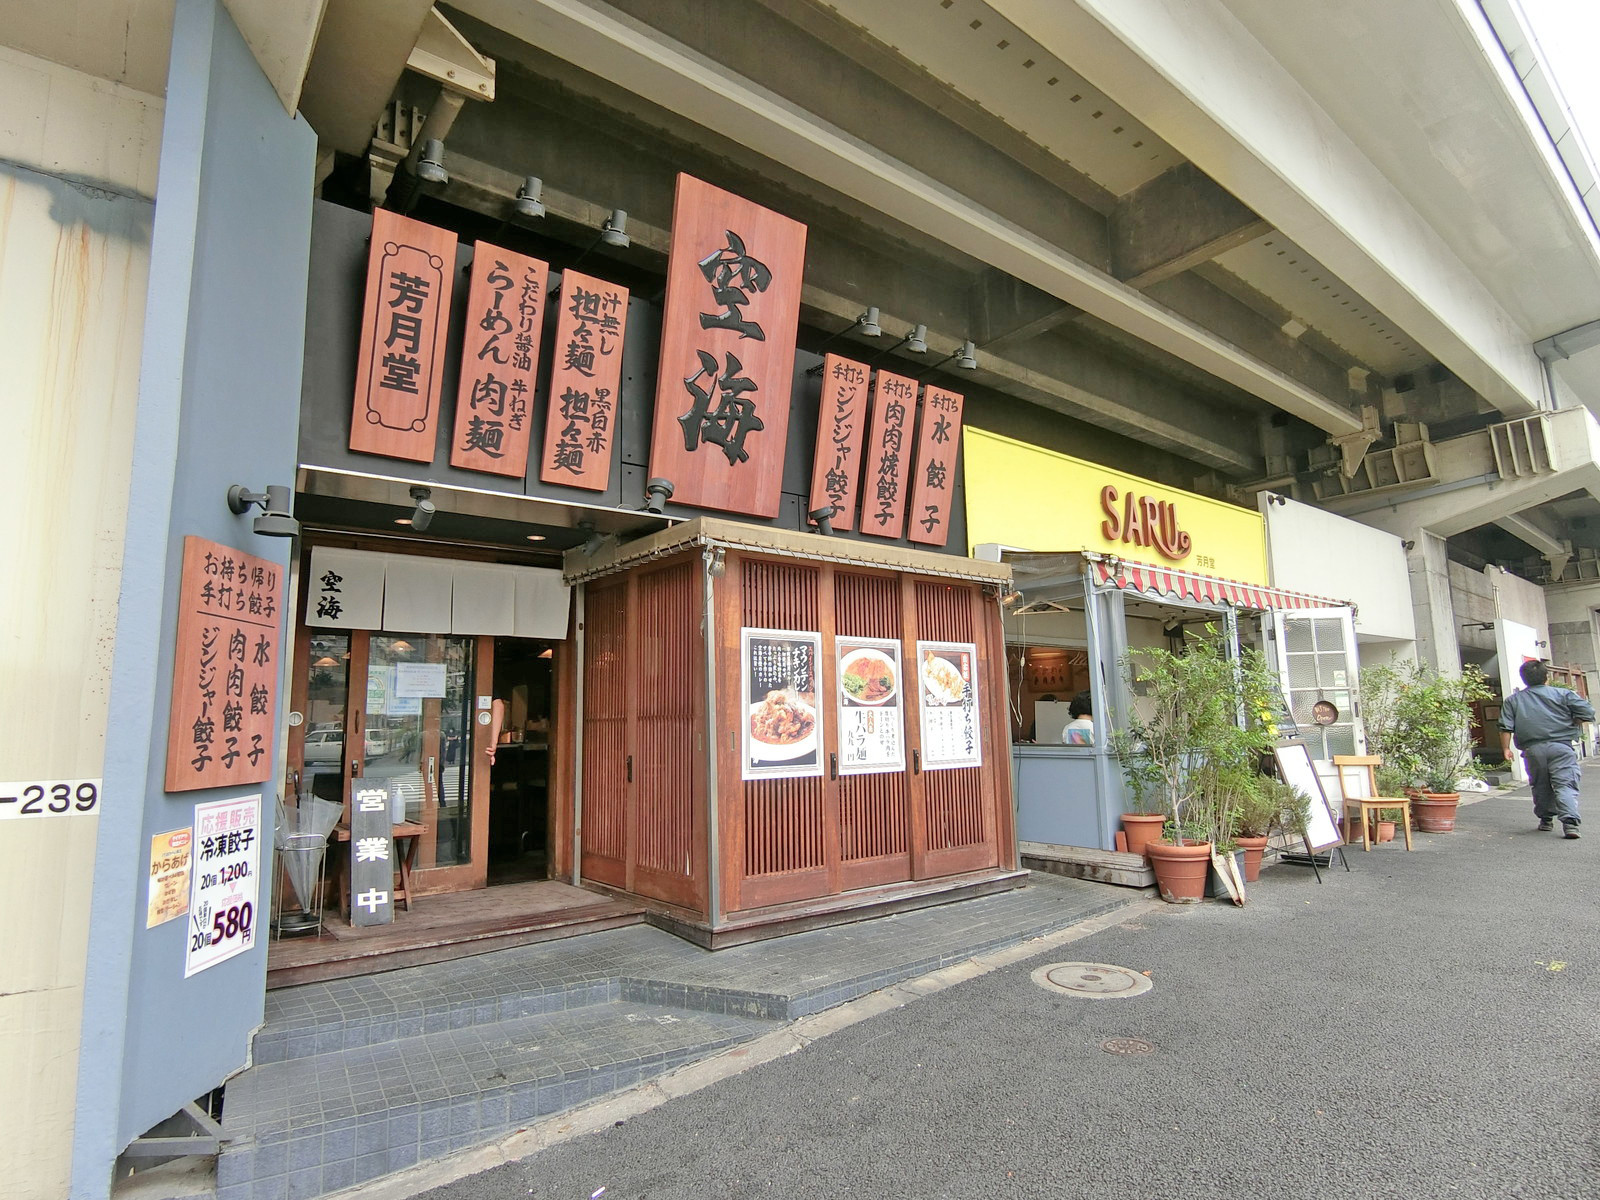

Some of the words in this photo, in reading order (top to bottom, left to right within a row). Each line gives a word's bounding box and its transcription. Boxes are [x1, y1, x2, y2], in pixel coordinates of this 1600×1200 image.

[379, 271, 430, 395] 芳月堂
[477, 260, 516, 366] らーめん
[512, 266, 540, 373] こだわり醤油
[562, 285, 601, 378] 担々麺
[598, 291, 622, 356] 汁無し
[677, 229, 773, 467] 空海
[460, 372, 509, 460] 肉麺
[508, 379, 529, 432] 牛ねぎ
[831, 362, 865, 385] 手打ち
[883, 379, 913, 400] 手打ち
[930, 393, 959, 413] 手打ち
[549, 386, 591, 476] 担々麺
[585, 387, 612, 455] 黒白赤
[824, 385, 857, 519] ジンジャー餃子
[874, 402, 906, 527] 肉肉焼餃子
[920, 414, 952, 534] 水餃子
[1101, 485, 1192, 560] SARU
[200, 579, 276, 619] 手打ち餃子
[204, 551, 276, 593] お持ち帰り
[316, 569, 344, 621] 空海
[191, 626, 221, 772] ジンジャー餃子
[220, 627, 248, 770] 肉肉餃子
[247, 633, 271, 767] 水餃子
[200, 828, 255, 862] 冷凍餃子
[355, 788, 389, 913] 営業中
